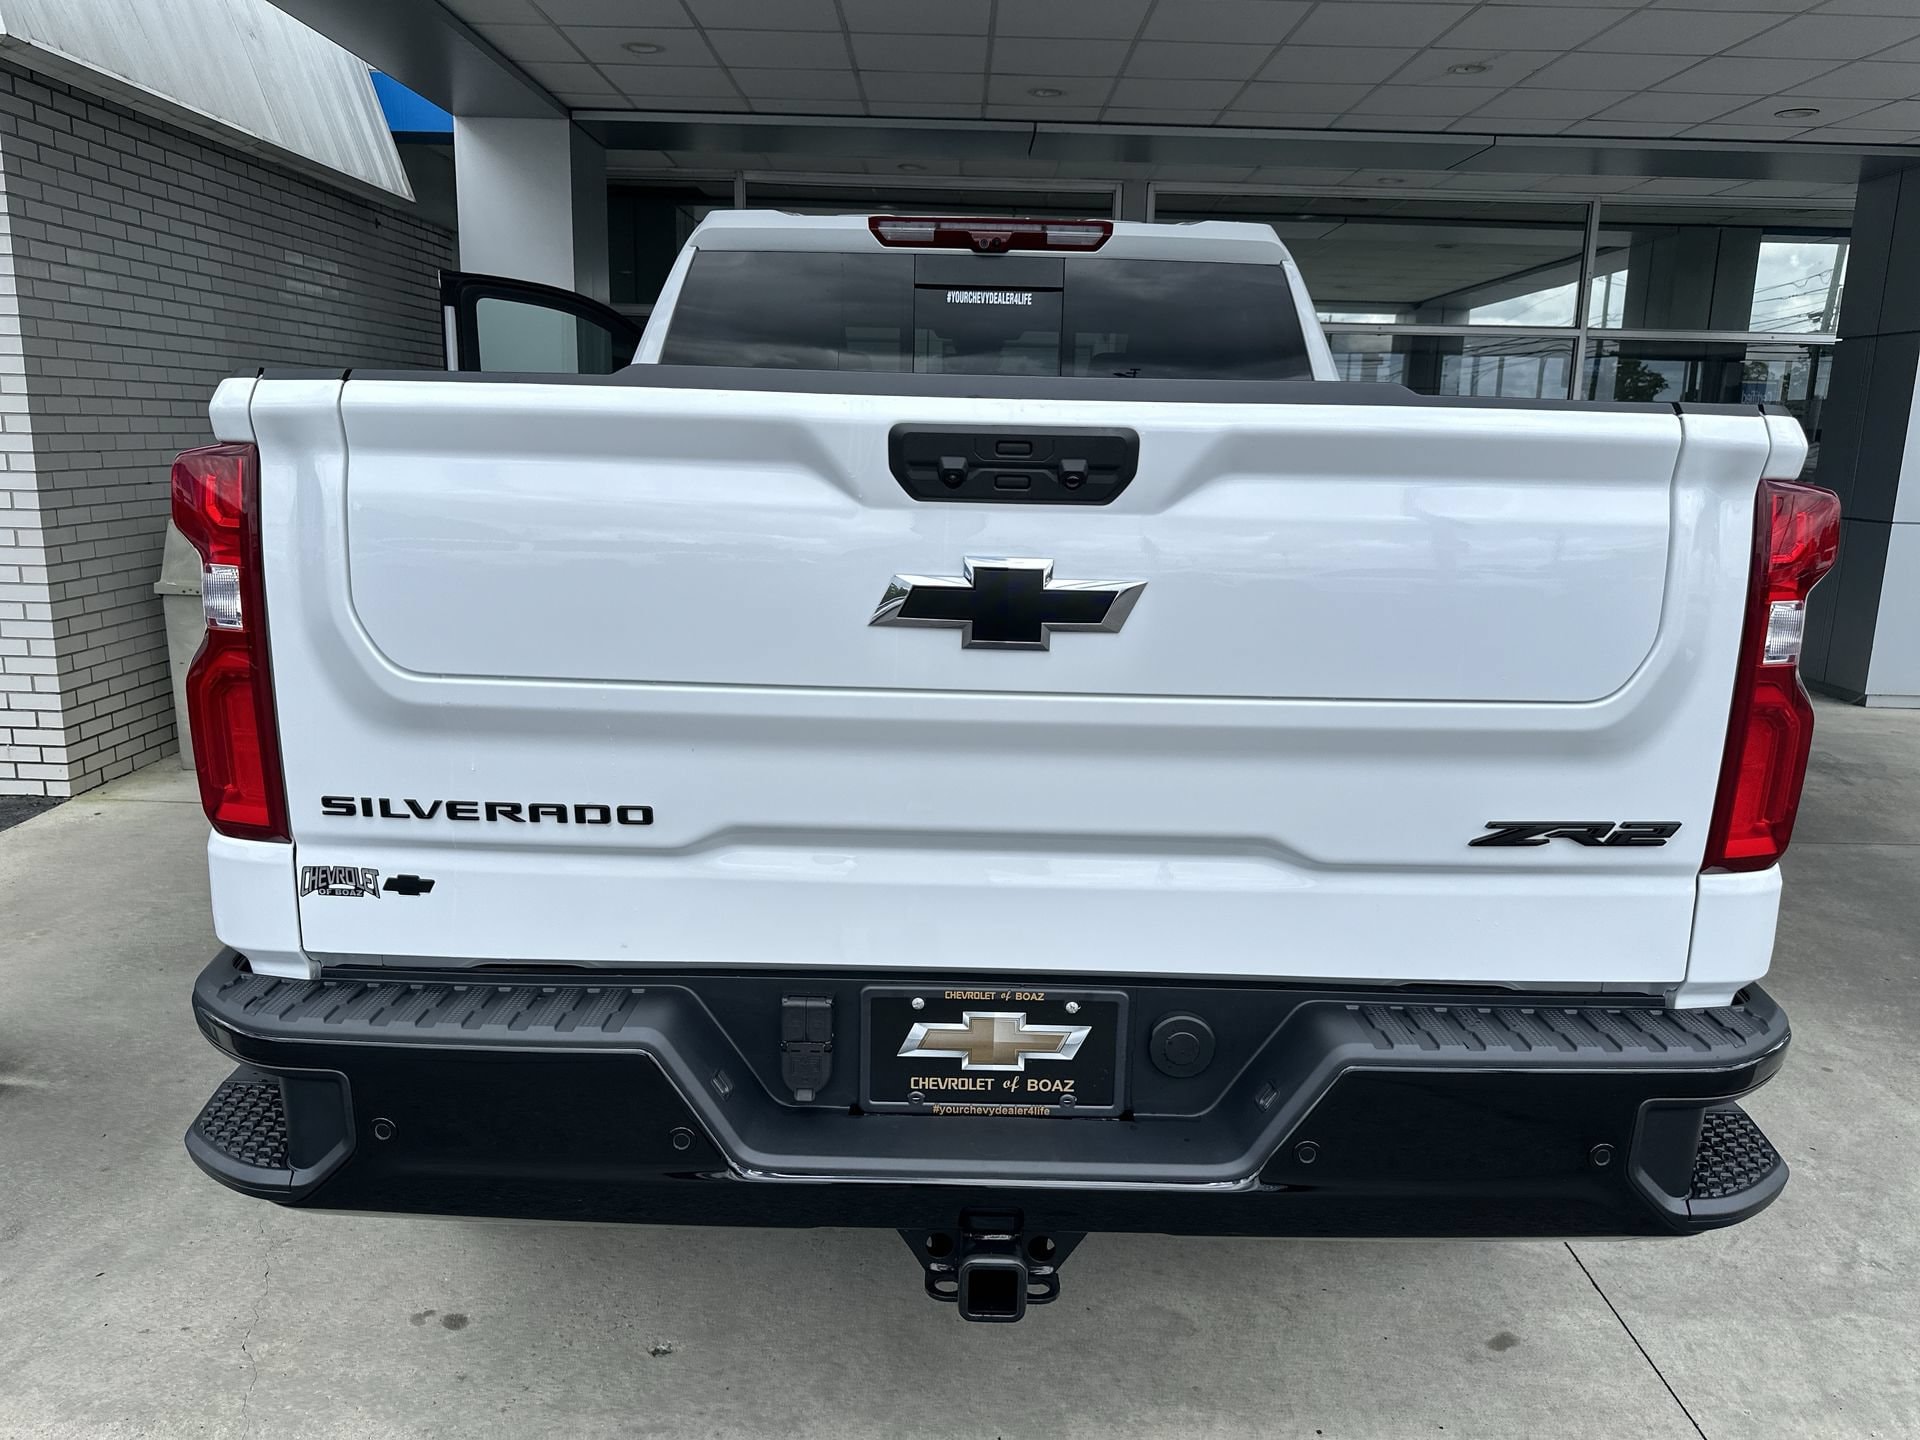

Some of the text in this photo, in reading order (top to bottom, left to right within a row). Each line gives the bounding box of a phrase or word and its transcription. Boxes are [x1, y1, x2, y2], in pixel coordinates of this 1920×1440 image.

[947, 291, 1032, 305] #YOURCHEVYDEALER4LIFE
[321, 795, 654, 825] SILVERADO
[1467, 821, 1683, 847] ZR2
[300, 866, 380, 898] CHEVROLET
[335, 888, 364, 897] BOAZ
[944, 990, 1045, 1001] CHEVROLET of BOAZ
[910, 1075, 1075, 1093] CHEVROLET of BOAZ
[932, 1103, 1050, 1117] #yourchevydealer4life
